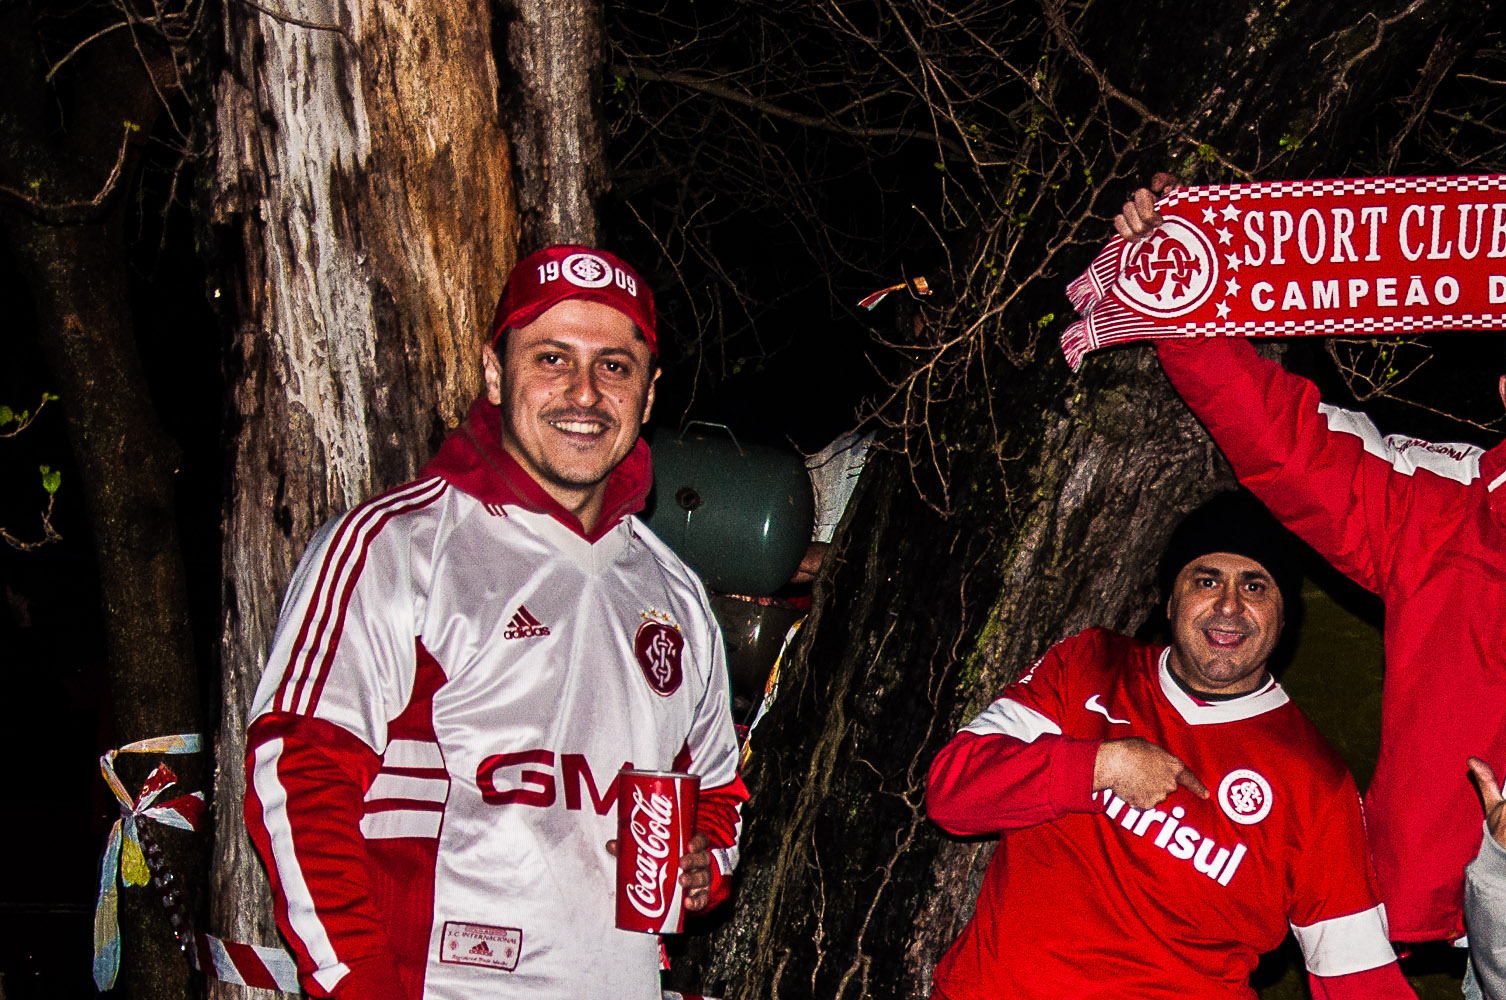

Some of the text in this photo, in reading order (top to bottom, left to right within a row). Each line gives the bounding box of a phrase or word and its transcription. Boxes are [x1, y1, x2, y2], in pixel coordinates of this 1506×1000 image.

[1243, 206, 1388, 267] SPORT
[537, 261, 637, 297] 19 09
[503, 624, 551, 640] adidas
[476, 749, 635, 816] GM
[626, 784, 673, 918] Coca-Cola
